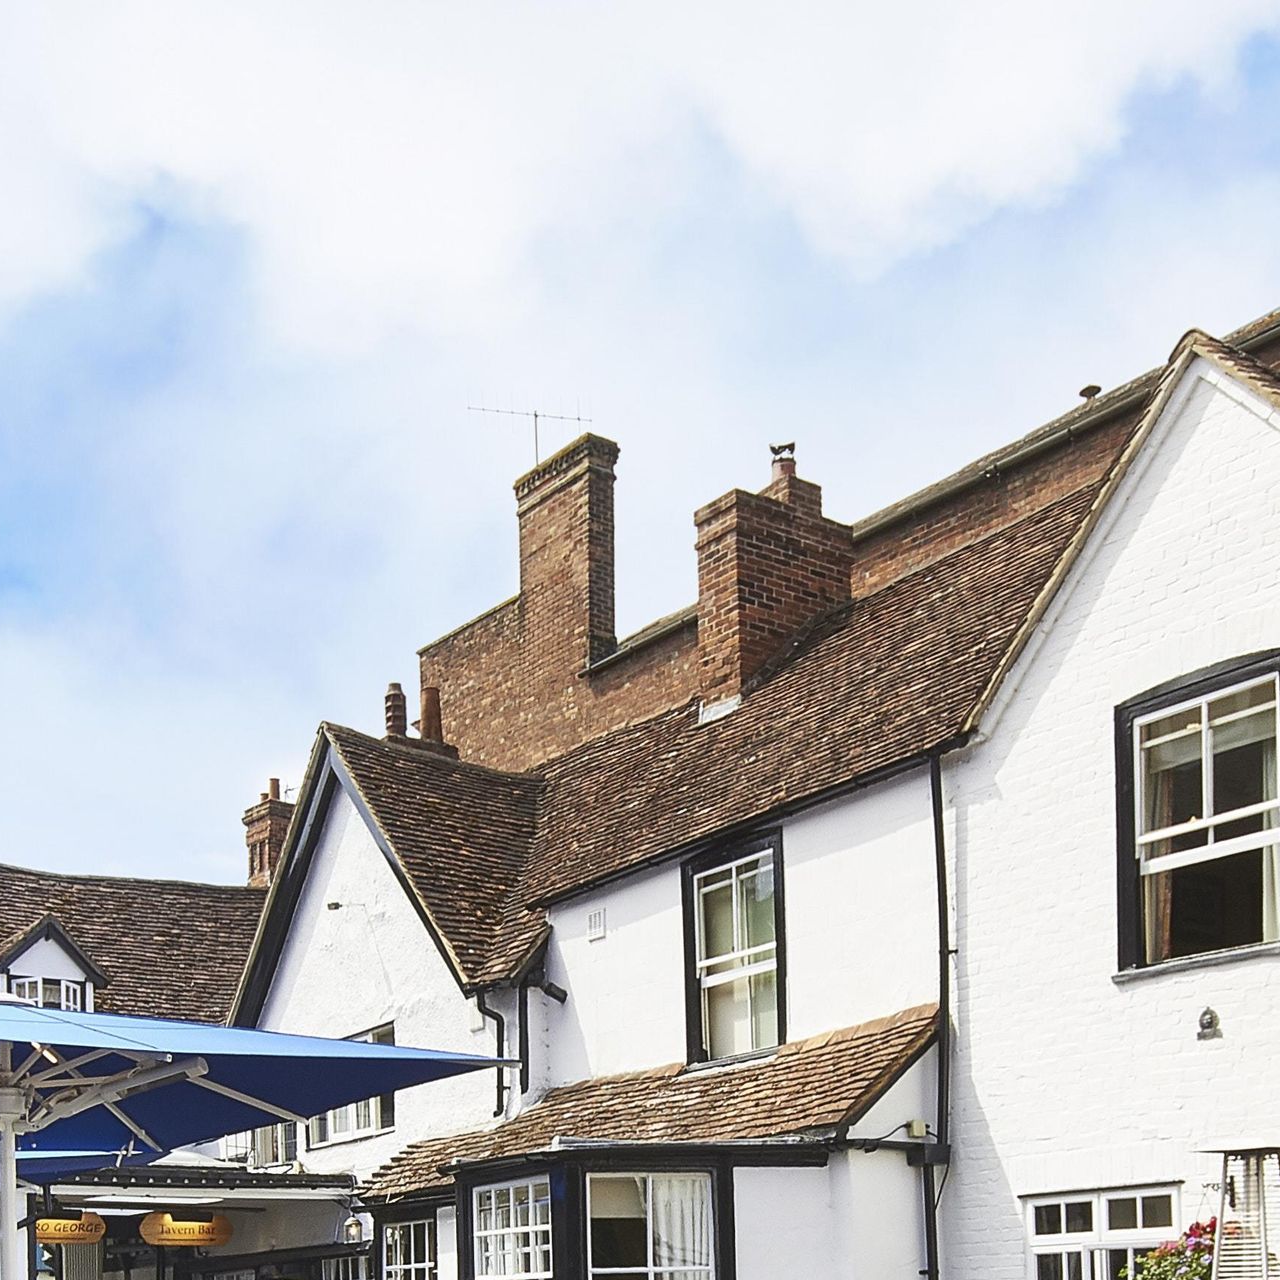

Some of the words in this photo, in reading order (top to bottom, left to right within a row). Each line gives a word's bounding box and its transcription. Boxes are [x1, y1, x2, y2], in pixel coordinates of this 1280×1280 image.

[54, 1222, 100, 1233] GEORGE
[160, 1224, 195, 1235] Tavern
[198, 1224, 216, 1235] Bar
